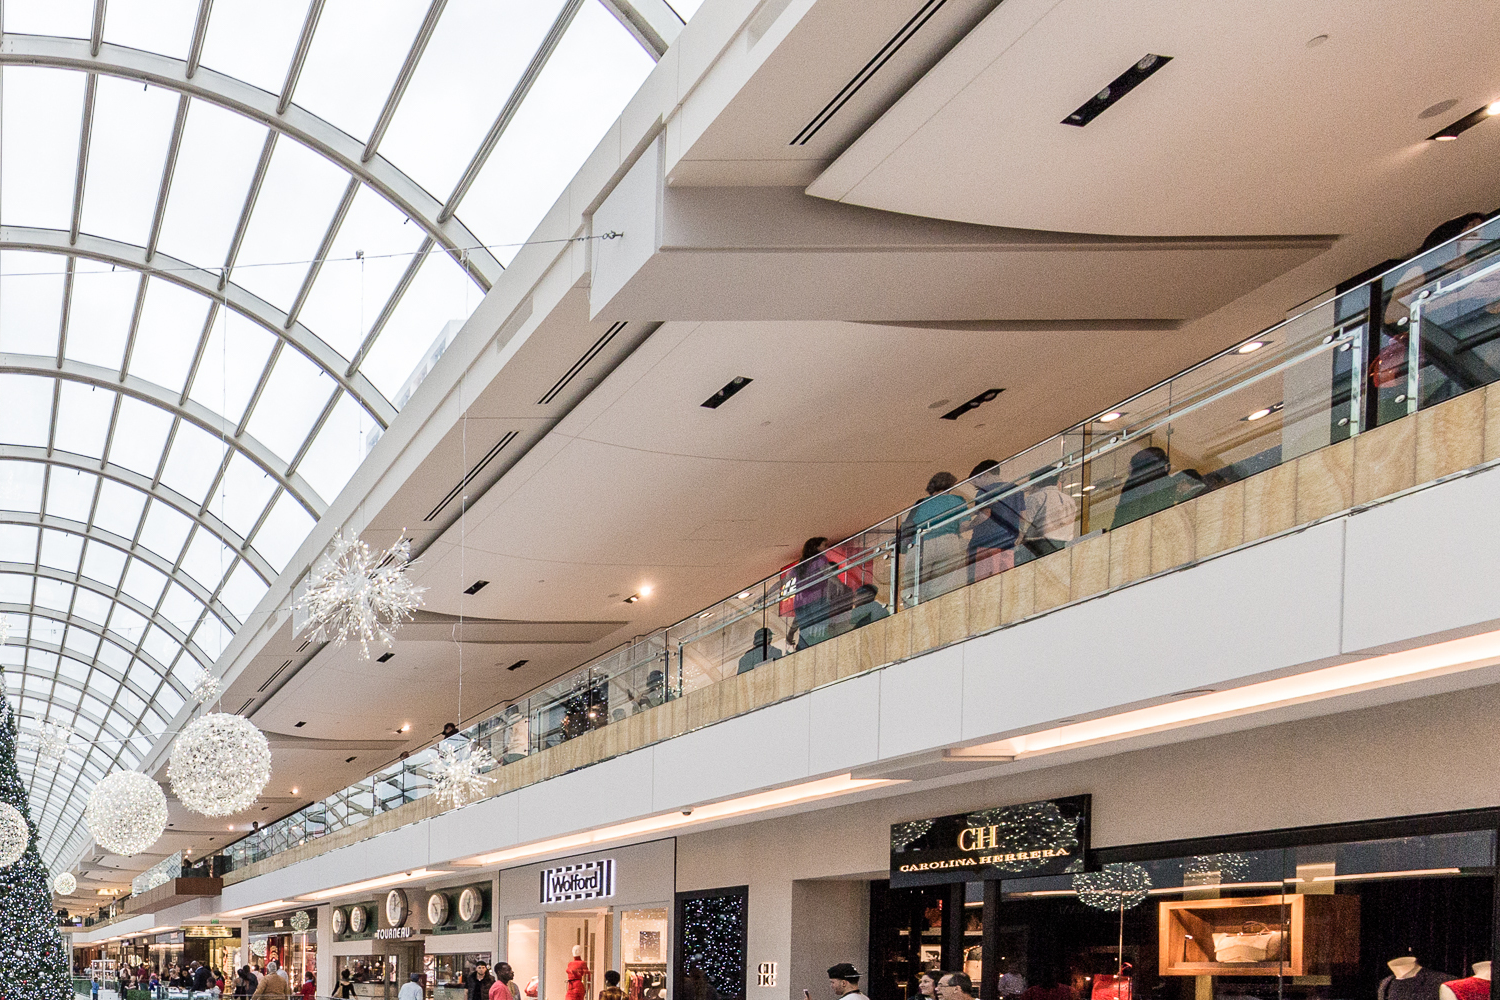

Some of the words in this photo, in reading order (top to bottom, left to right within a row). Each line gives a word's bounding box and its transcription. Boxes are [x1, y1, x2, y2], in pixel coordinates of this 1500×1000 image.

[957, 825, 999, 852] CH
[900, 857, 977, 873] CAROLINA
[979, 847, 1070, 866] HERRERA
[551, 870, 598, 894] Wolford
[376, 926, 411, 941] TOURNEAU
